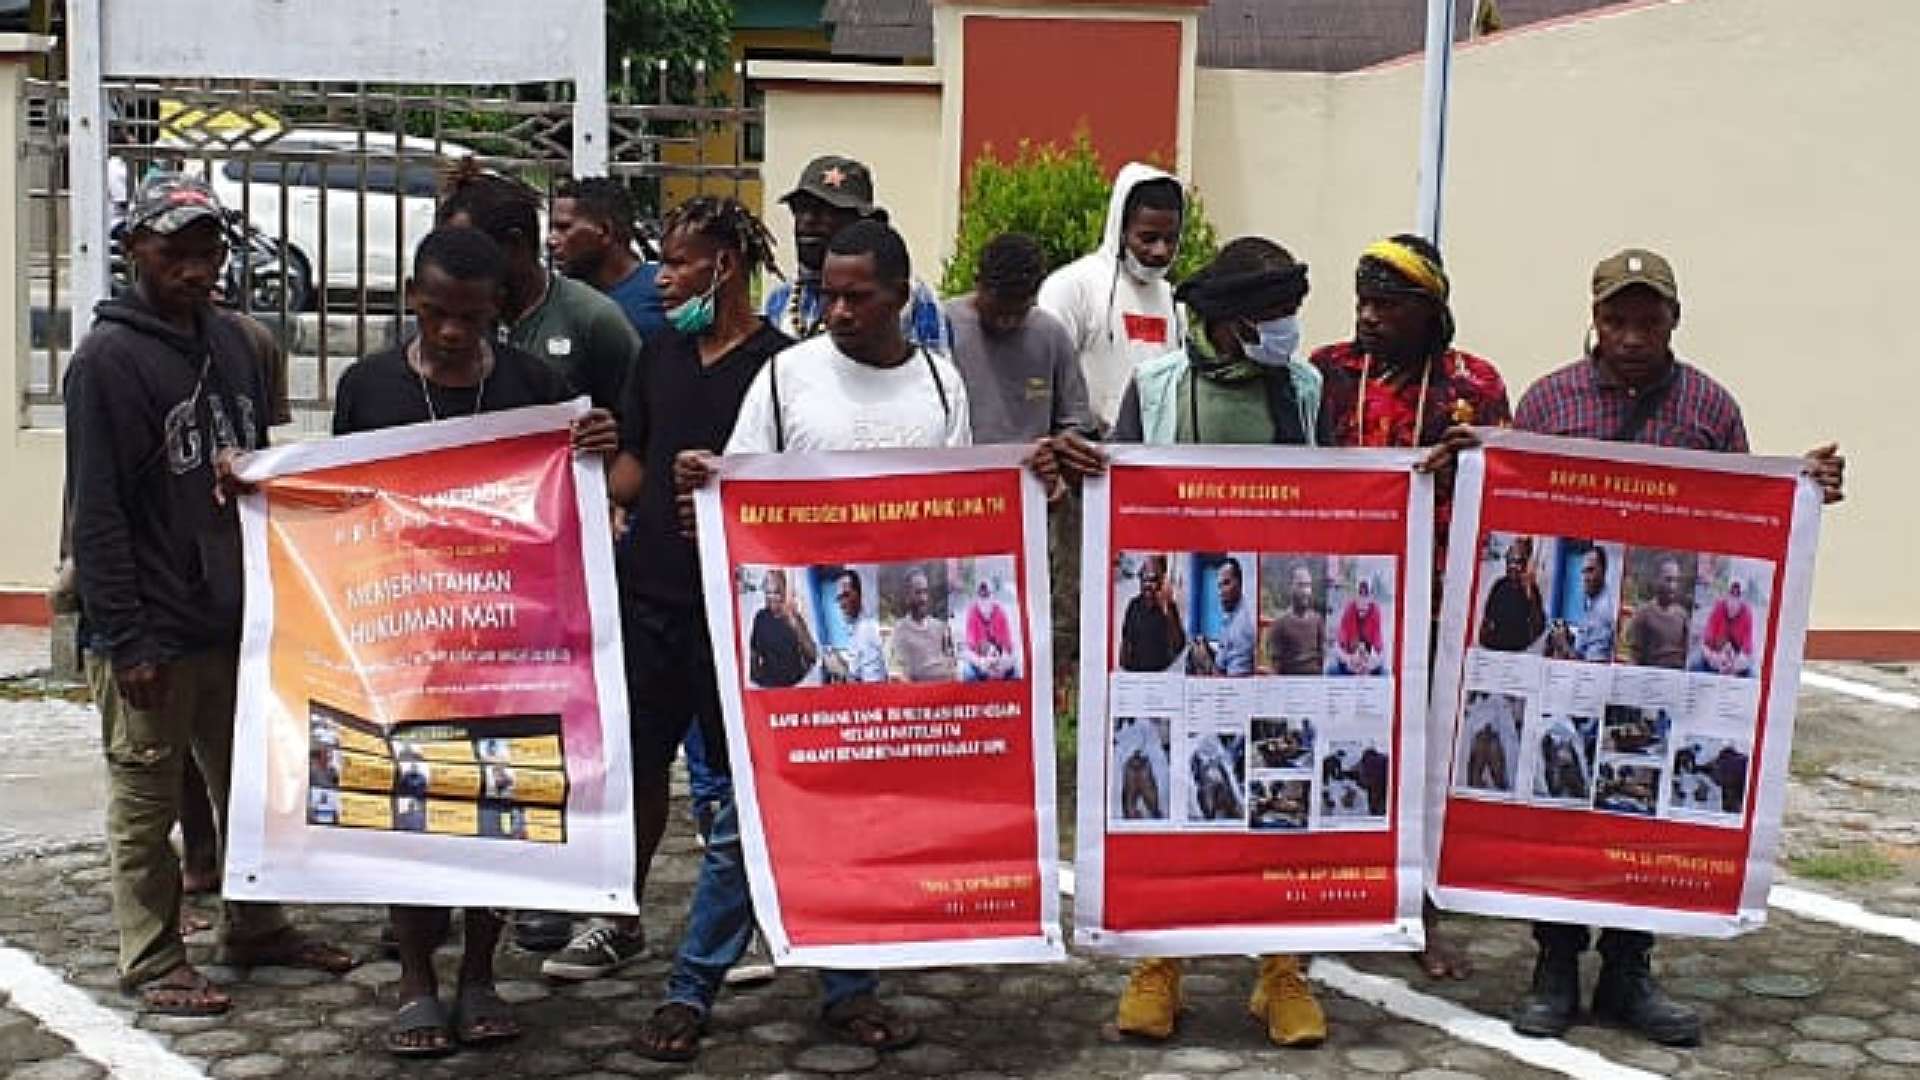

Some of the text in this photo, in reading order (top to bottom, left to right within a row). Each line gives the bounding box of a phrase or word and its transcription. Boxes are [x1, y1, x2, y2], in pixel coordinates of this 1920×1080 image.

[347, 570, 512, 607] MEMERINTAHKAN
[350, 600, 516, 643] HUKUMAN MATI
